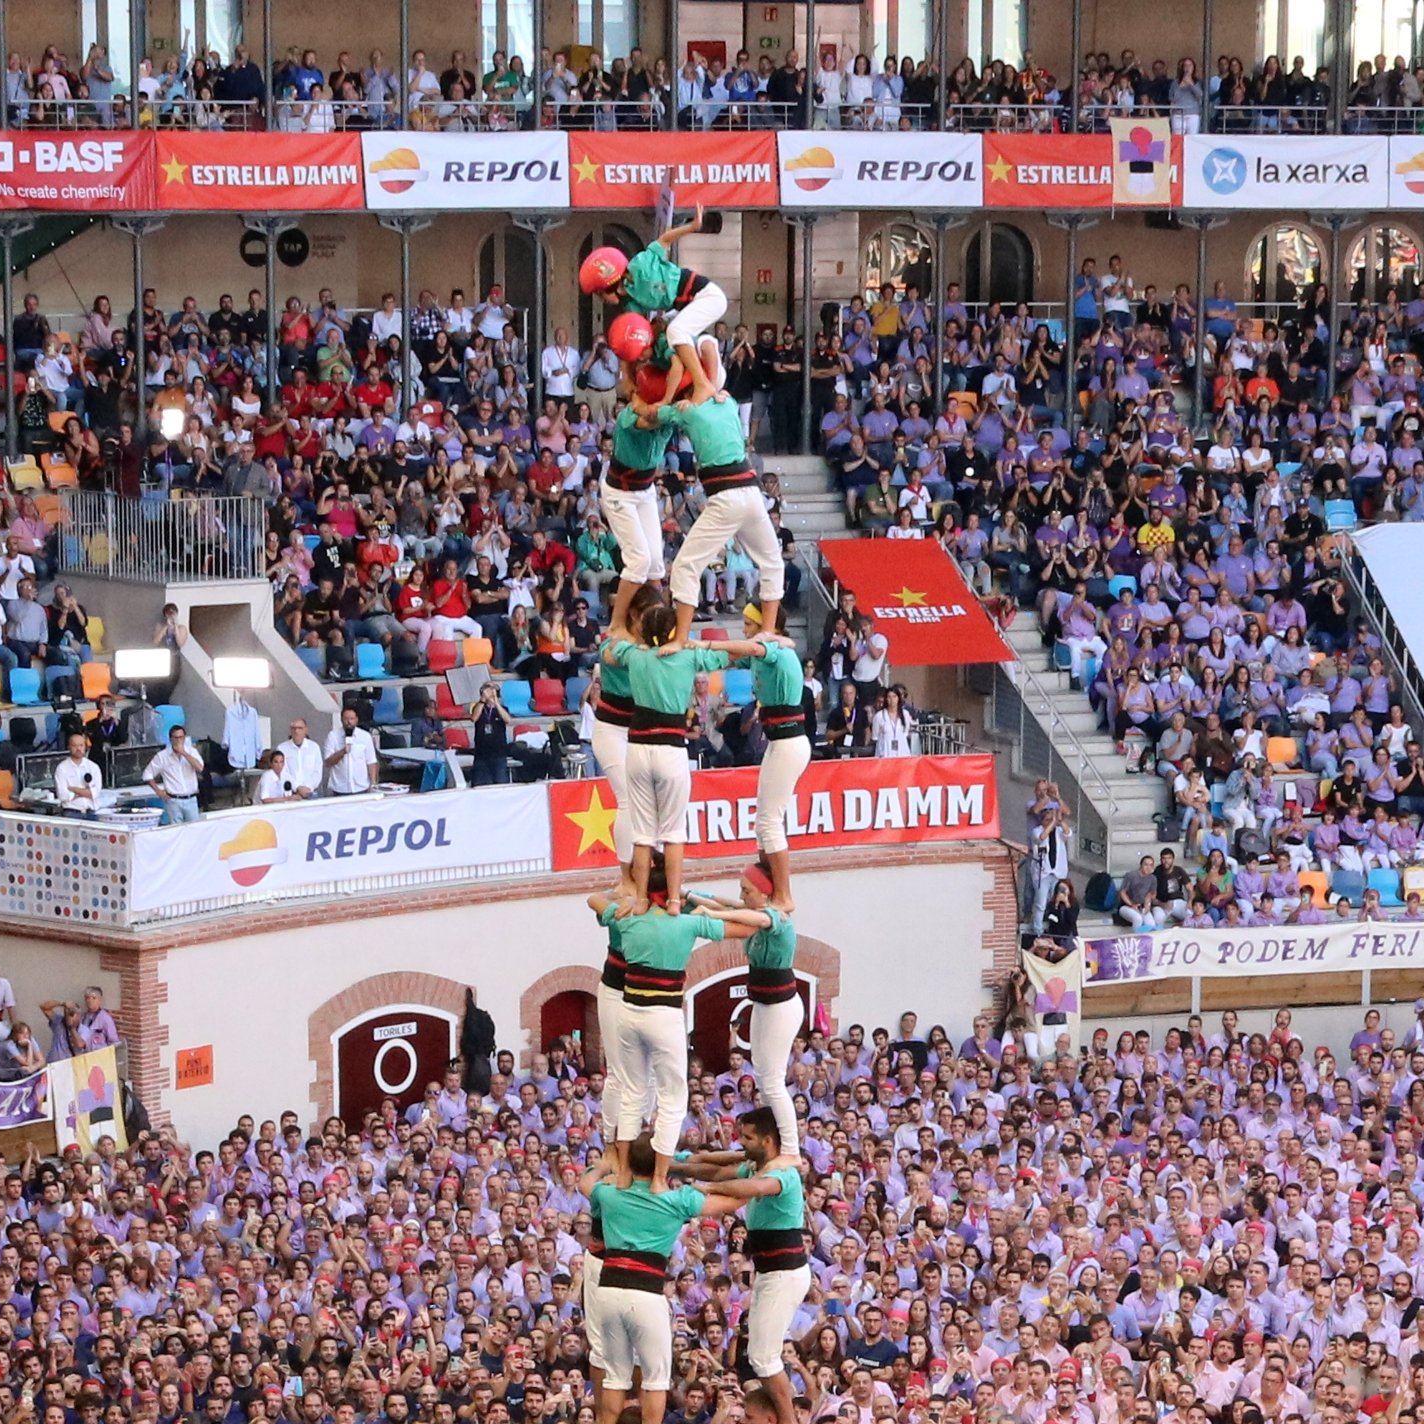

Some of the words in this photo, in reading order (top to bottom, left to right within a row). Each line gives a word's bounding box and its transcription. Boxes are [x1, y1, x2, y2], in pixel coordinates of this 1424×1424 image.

[34, 141, 124, 172] BASF
[191, 164, 290, 186] ESTRELLA
[293, 163, 358, 186] DAMM
[442, 160, 563, 183] REPSOL
[707, 163, 771, 184] DAMM
[857, 159, 977, 182] REPSOL
[1017, 164, 1112, 185] ESTRELLA
[1256, 156, 1279, 184] la
[1284, 162, 1370, 184] xarxa
[17, 183, 58, 199] create
[60, 184, 127, 202] chemistry
[873, 604, 967, 619] ESTRELLA
[907, 616, 942, 624] DAMM
[842, 784, 985, 830] DAMM
[305, 817, 452, 862] REPSOL
[1156, 936, 1202, 967] HO
[1217, 935, 1329, 965] PODEM
[1348, 929, 1421, 962] FER!
[378, 1024, 413, 1038] TORILES
